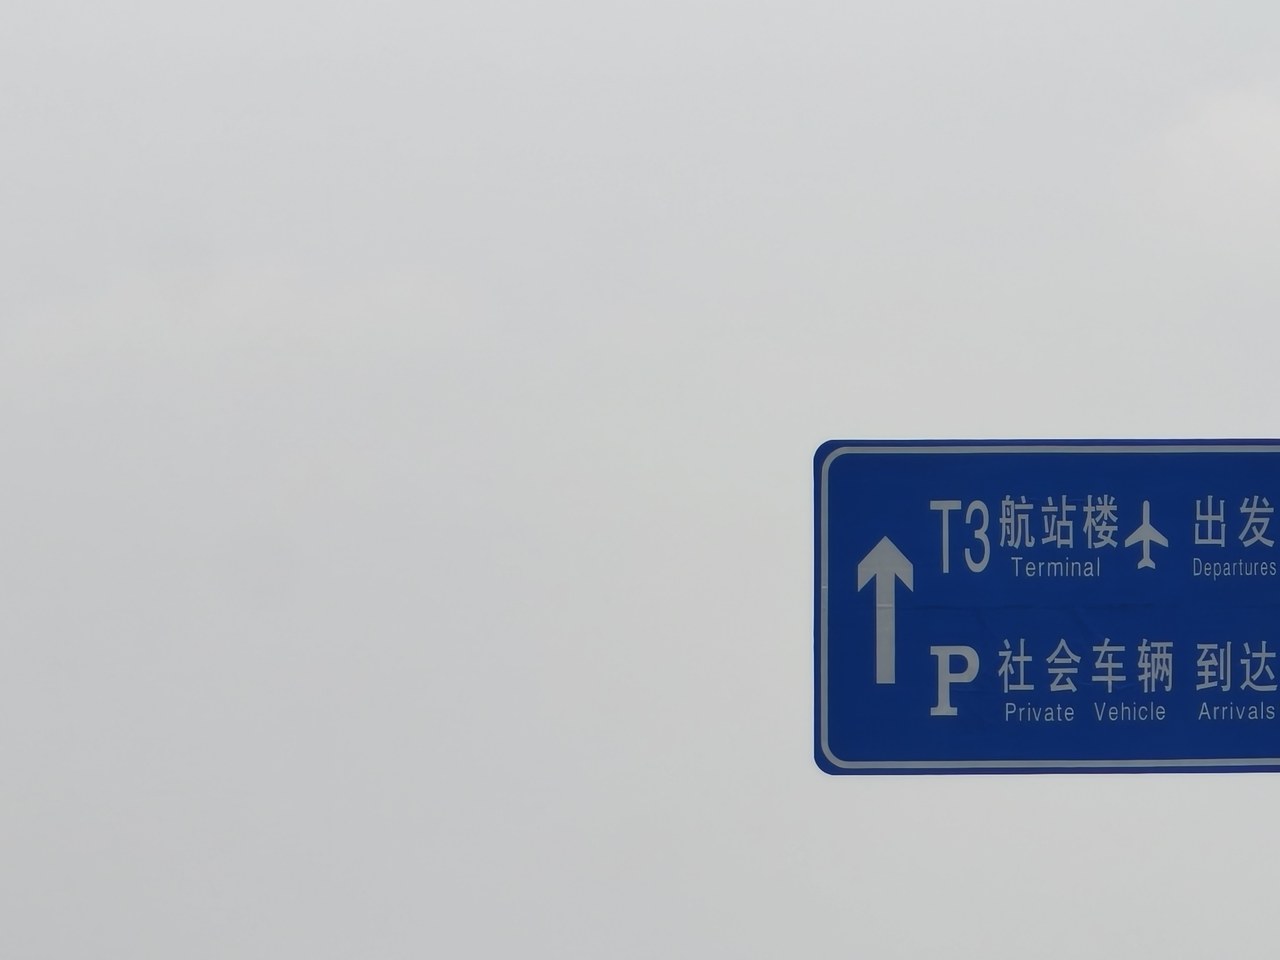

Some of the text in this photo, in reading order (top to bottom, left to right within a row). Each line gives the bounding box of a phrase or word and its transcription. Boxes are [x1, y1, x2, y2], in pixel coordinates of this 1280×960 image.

[930, 500, 990, 574] T3
[999, 494, 1119, 549] 航站楼
[1194, 495, 1276, 548] 出发
[1011, 556, 1100, 577] Terminal
[1193, 557, 1277, 579] Departures
[930, 645, 980, 716] P
[998, 637, 1174, 693] 社会车辆
[1196, 640, 1278, 692] 到达
[1005, 702, 1166, 722] Private Vehicle
[1198, 701, 1275, 720] Arrivals
